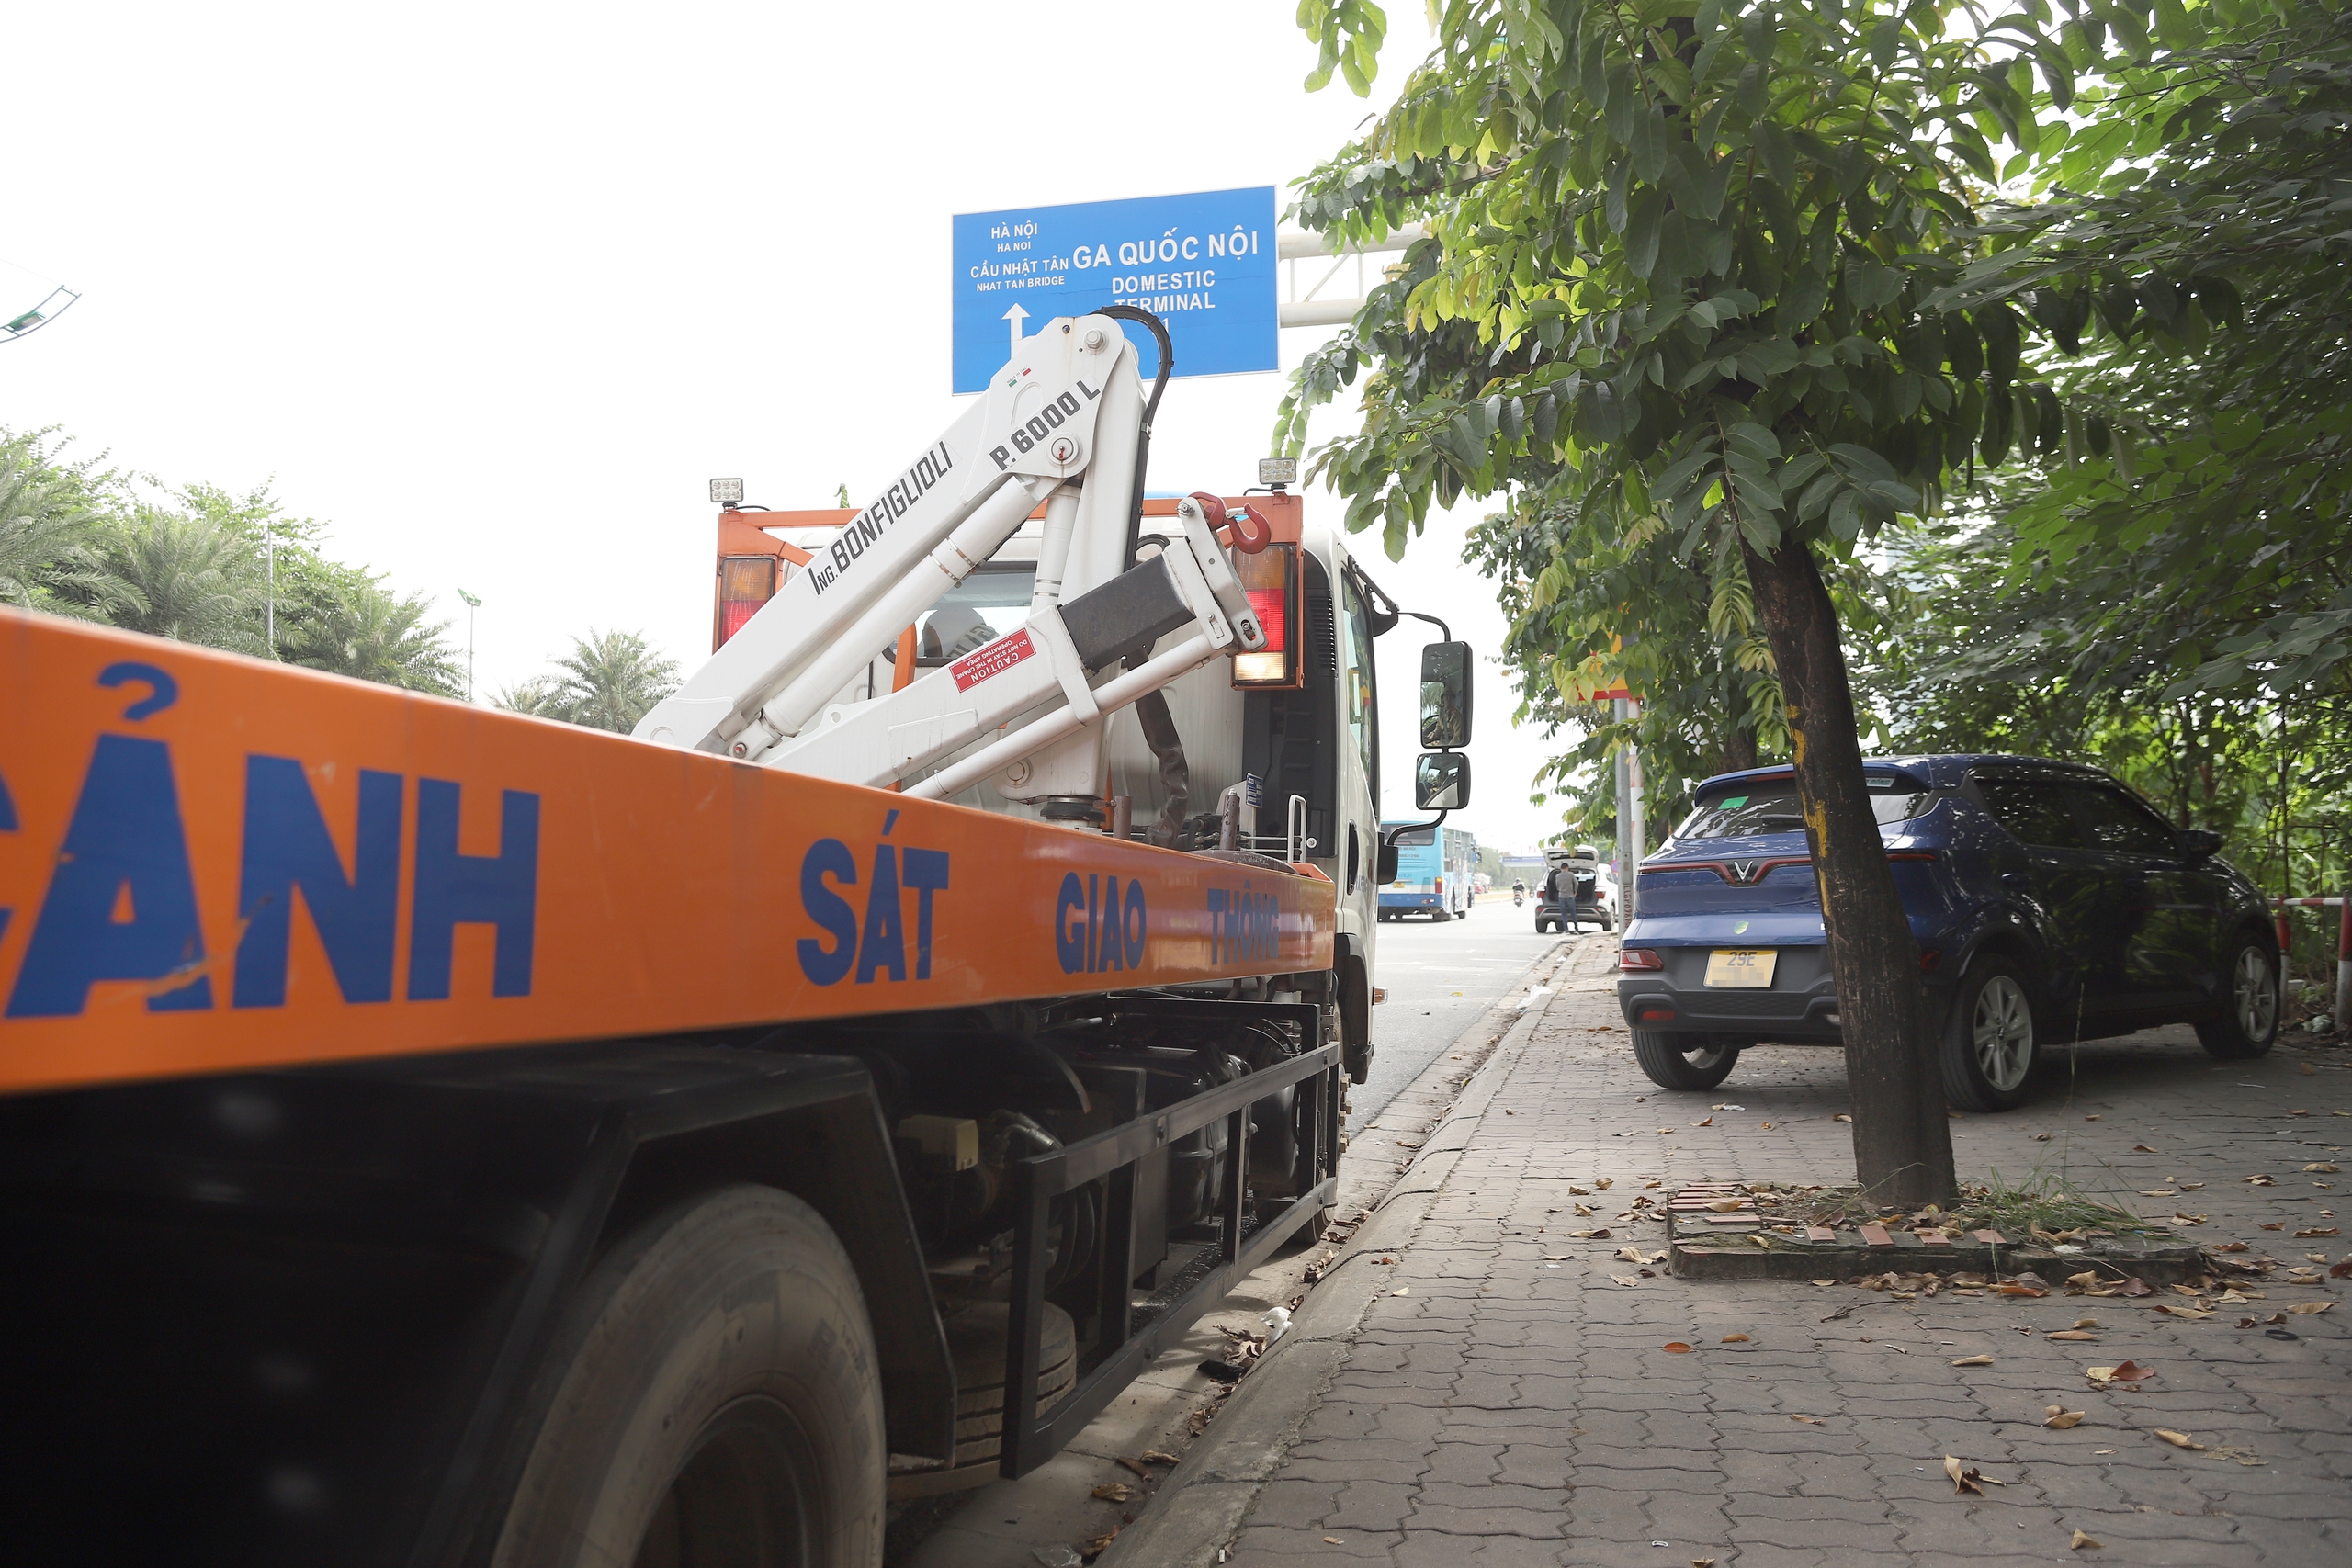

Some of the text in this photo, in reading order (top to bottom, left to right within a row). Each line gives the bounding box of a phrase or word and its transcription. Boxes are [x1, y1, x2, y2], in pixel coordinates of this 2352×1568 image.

[991, 220, 1038, 239] HÀ NỘI
[997, 241, 1031, 253] HA NOI
[1072, 224, 1258, 269] GA QUỐC NỘI
[970, 255, 1069, 278] CẦU NHẬT TÂN
[977, 276, 1065, 292] NHAT TAN BRIDGE
[1112, 269, 1216, 294] DOMESTIC
[1076, 379, 1101, 400] L
[831, 440, 953, 574] BONFIGLIOLI
[981, 639, 1012, 660] OPERATING
[1007, 643, 1019, 653] NOT
[1019, 639, 1028, 648] DO
[966, 656, 981, 667] AREA
[993, 649, 1007, 660] STAY
[956, 666, 976, 680] CRANE
[970, 652, 1019, 682] CAUTION
[976, 660, 987, 669] THE
[0, 661, 1279, 1021] ẢNH SÁT GIAO THÔNG
[1727, 951, 1758, 966] 29E
